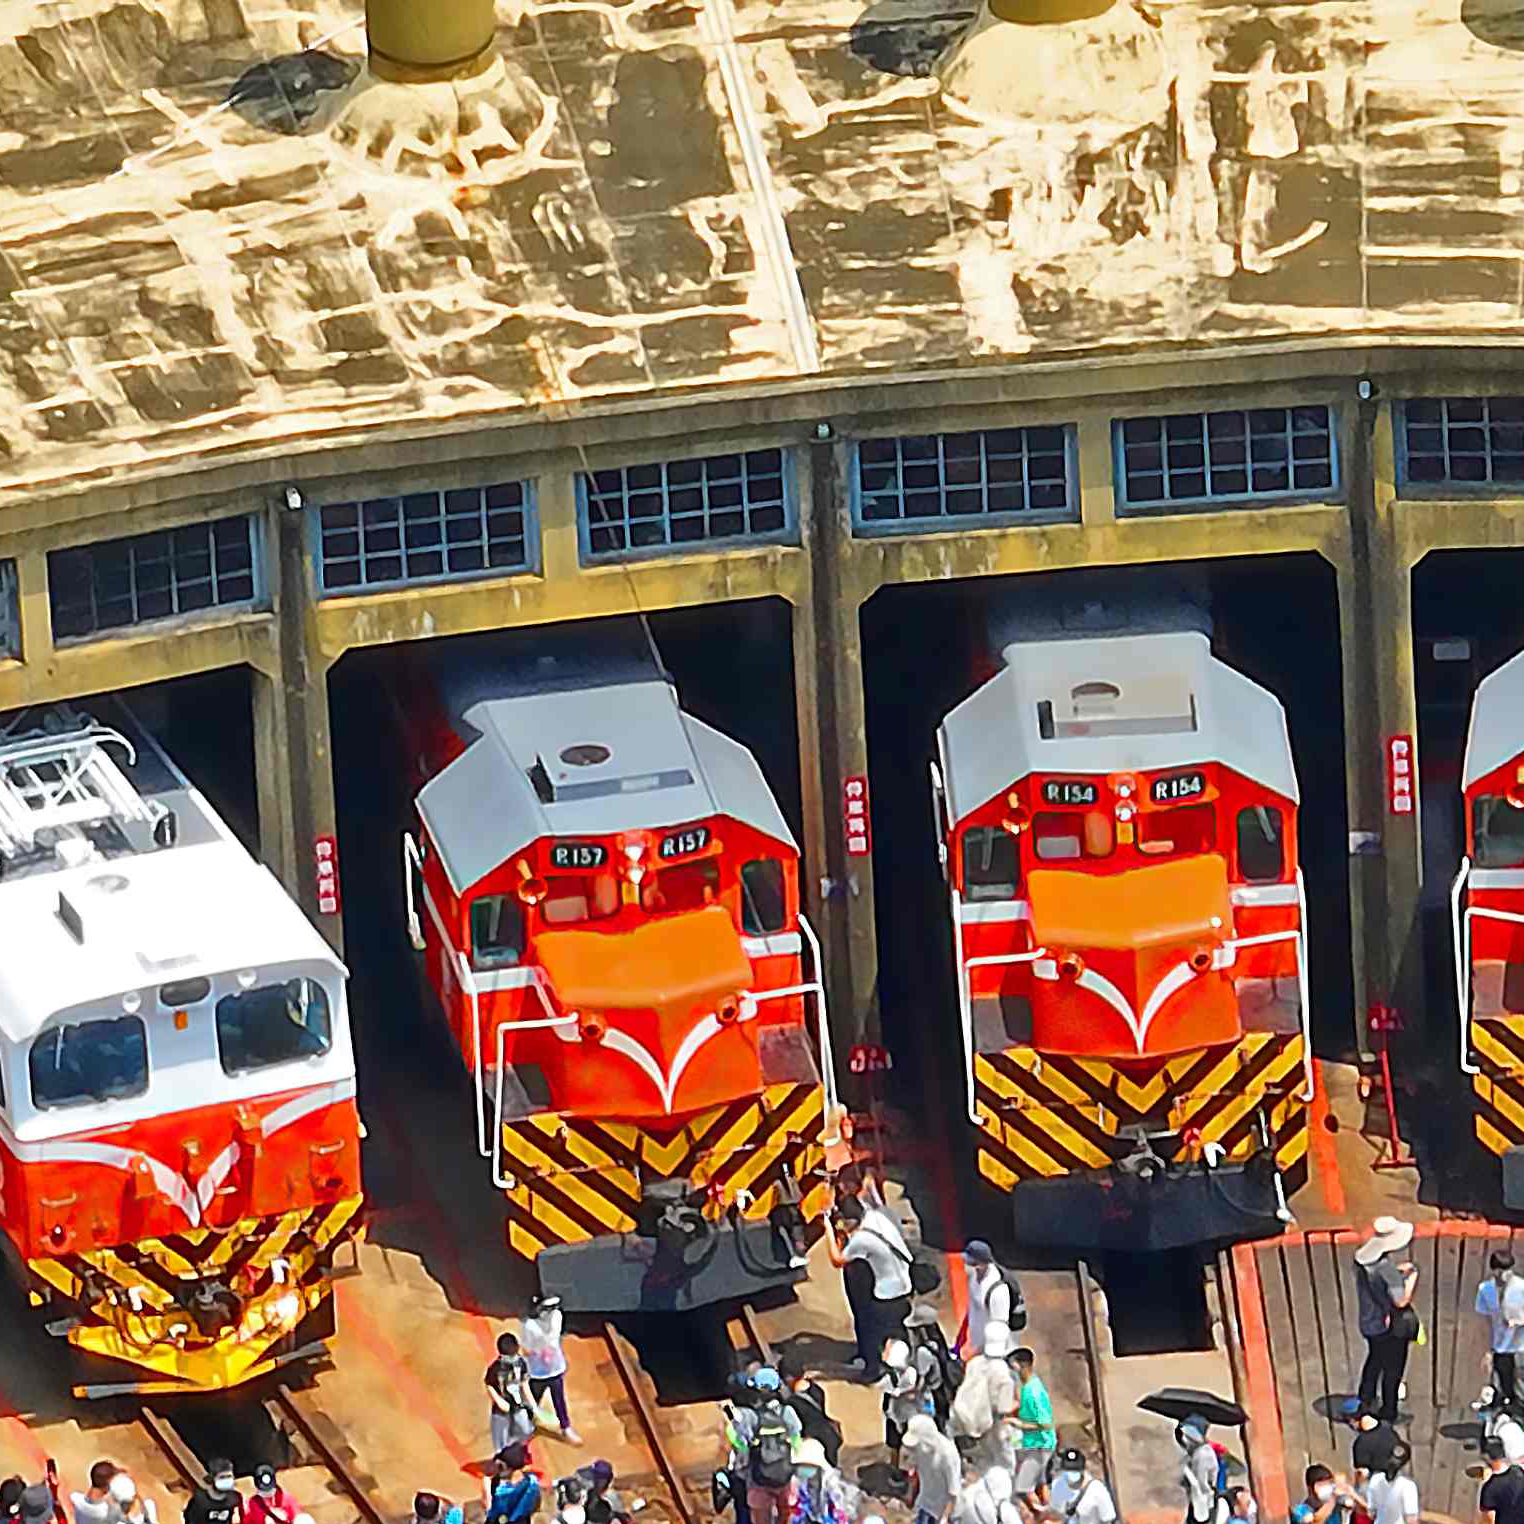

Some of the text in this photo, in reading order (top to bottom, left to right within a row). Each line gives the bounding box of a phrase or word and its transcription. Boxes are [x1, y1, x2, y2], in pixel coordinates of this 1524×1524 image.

[1047, 784, 1094, 802] R154
[1155, 776, 1201, 799] R154
[663, 829, 706, 855] R157
[556, 847, 603, 865] R157
